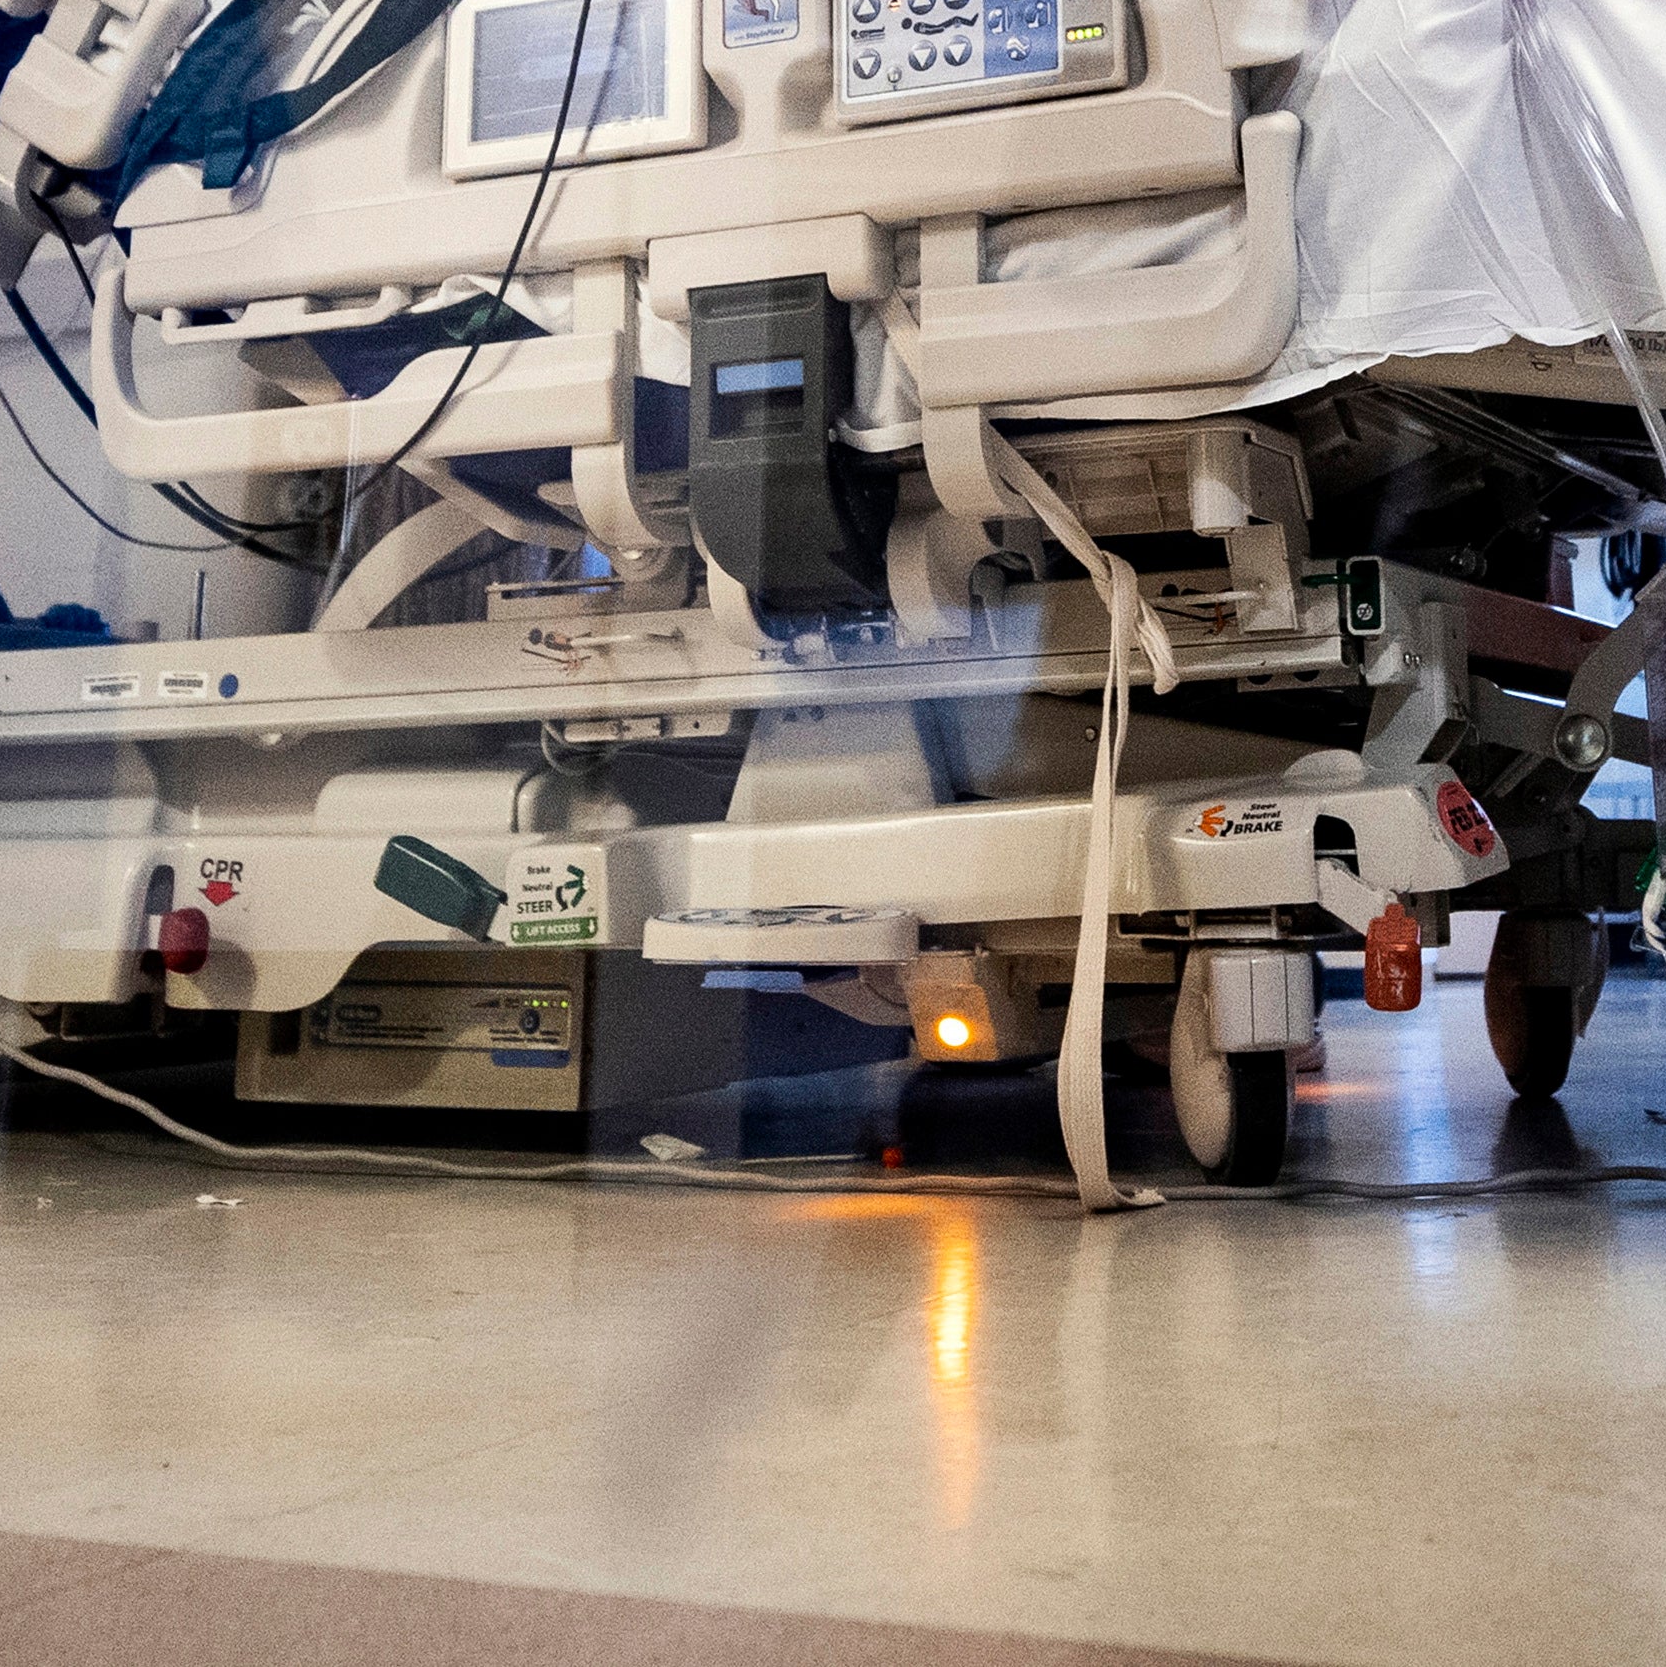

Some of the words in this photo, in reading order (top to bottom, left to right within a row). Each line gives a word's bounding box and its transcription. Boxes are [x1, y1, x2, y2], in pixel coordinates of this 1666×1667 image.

[1249, 803, 1278, 811] Steer
[1241, 810, 1282, 821] Neutral
[1233, 820, 1284, 835] BRAKE
[200, 857, 244, 883] CPR
[527, 865, 551, 875] Brake
[522, 881, 553, 893] Neutral
[516, 900, 554, 915] STEER
